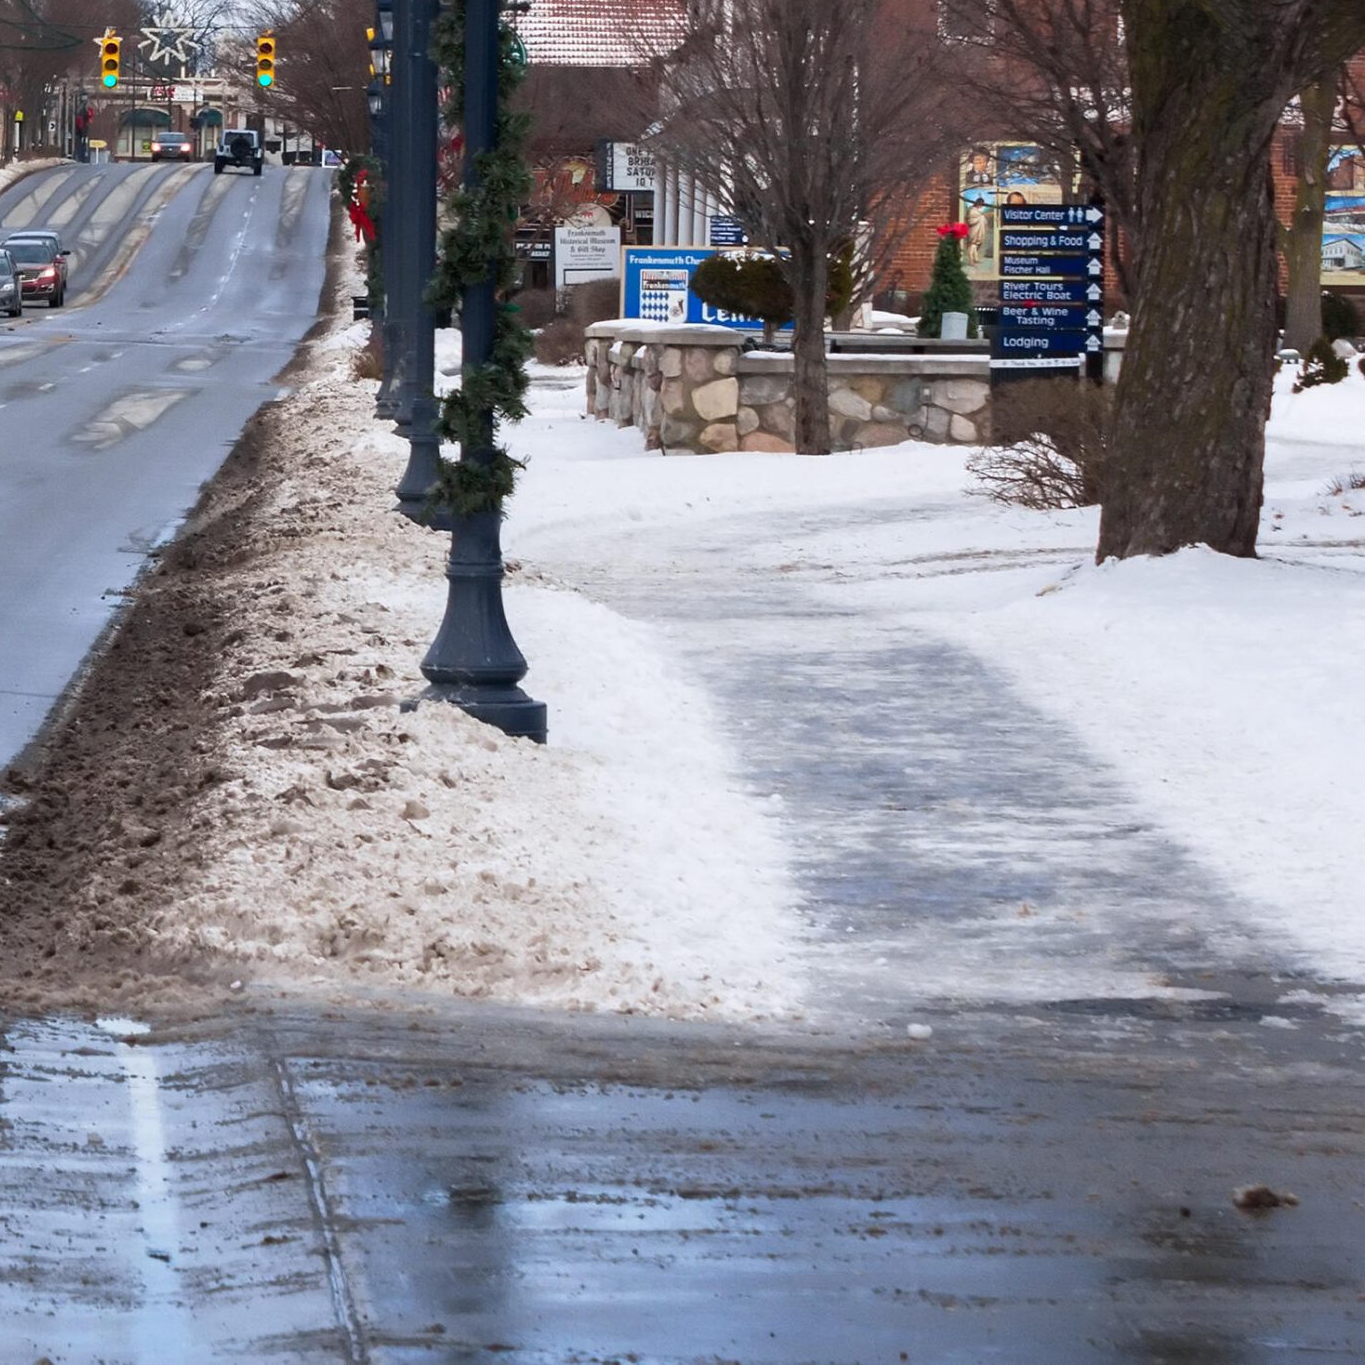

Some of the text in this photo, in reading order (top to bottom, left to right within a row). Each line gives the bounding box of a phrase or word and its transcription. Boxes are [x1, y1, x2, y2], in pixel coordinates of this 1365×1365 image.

[1004, 210, 1065, 220] Visitor Center
[1004, 235, 1083, 247] Shopping & Food
[630, 255, 684, 265] Frankenmuth
[1004, 257, 1038, 265] Museum
[1004, 266, 1051, 274] Fischer Hall
[1003, 282, 1064, 291] River Tours
[1003, 291, 1071, 300] Electric Boat
[1003, 307, 1069, 316] Beer & Wine
[1017, 316, 1055, 326] Tasting
[1003, 337, 1049, 349] Lodging
